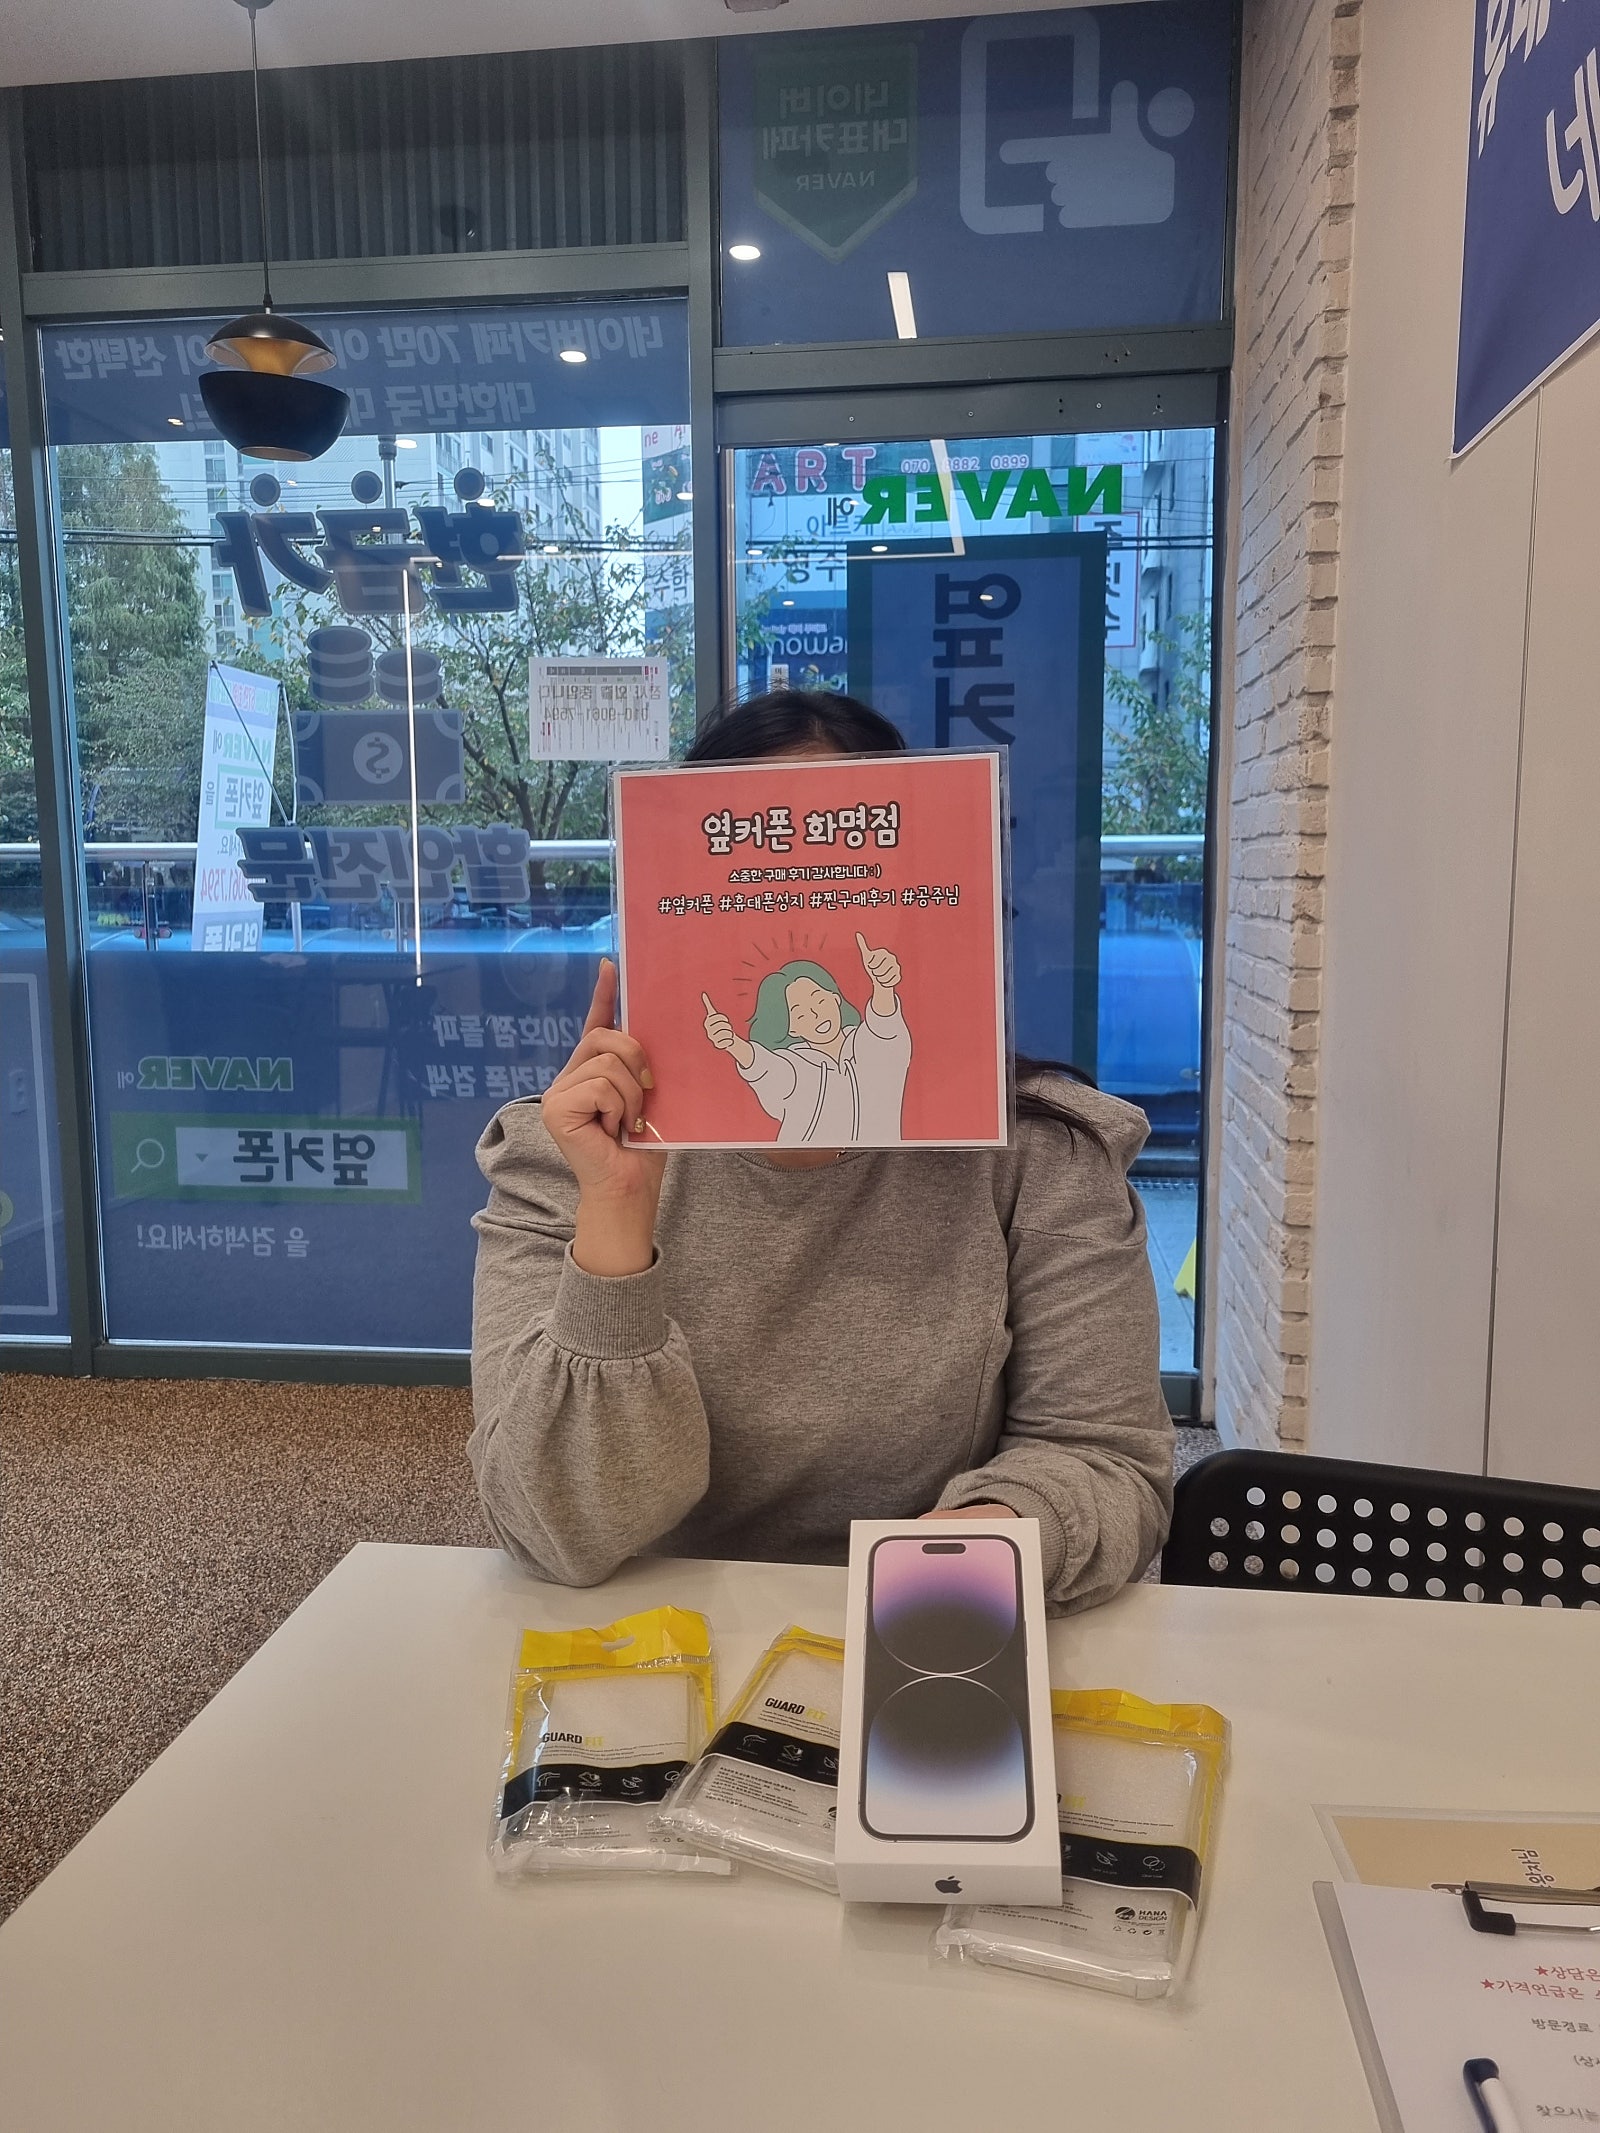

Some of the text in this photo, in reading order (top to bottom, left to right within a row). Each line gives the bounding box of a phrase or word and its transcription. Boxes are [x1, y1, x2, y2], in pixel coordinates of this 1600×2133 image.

[752, 446, 877, 495] ART
[901, 459, 931, 474] 070
[990, 454, 1030, 470] 0899
[701, 800, 901, 856] 옆커폰 화명점
[728, 869, 762, 883] 소중한
[763, 867, 787, 882] 구매
[788, 867, 810, 881] 후기
[658, 883, 960, 915] #옆커폰 #휴대폰성지 #찐구매후기 #공주님
[765, 1697, 827, 1721] GUARD FIT
[542, 1731, 604, 1747] GUARD FIT
[1497, 1979, 1585, 2000] 가격언급은
[1531, 2018, 1594, 2033] 방문경로
